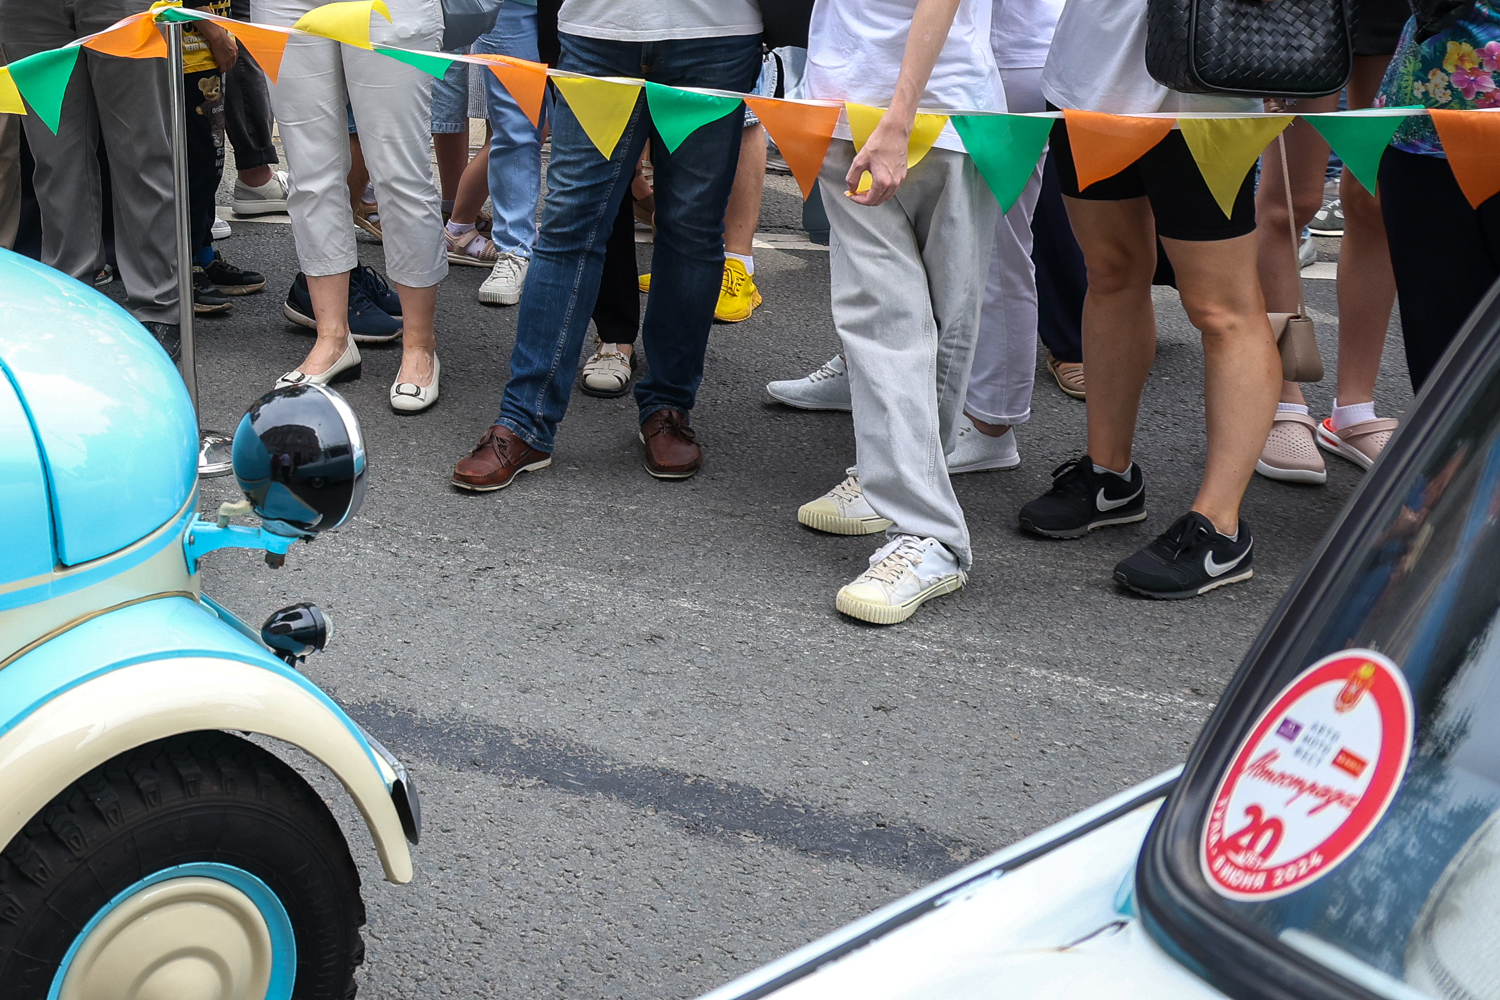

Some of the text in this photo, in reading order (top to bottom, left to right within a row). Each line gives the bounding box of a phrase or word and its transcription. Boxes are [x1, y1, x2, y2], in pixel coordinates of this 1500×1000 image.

[1218, 804, 1285, 861] 20
[1221, 864, 1268, 890] ИЮНЯ
[1272, 851, 1324, 888] 2024
